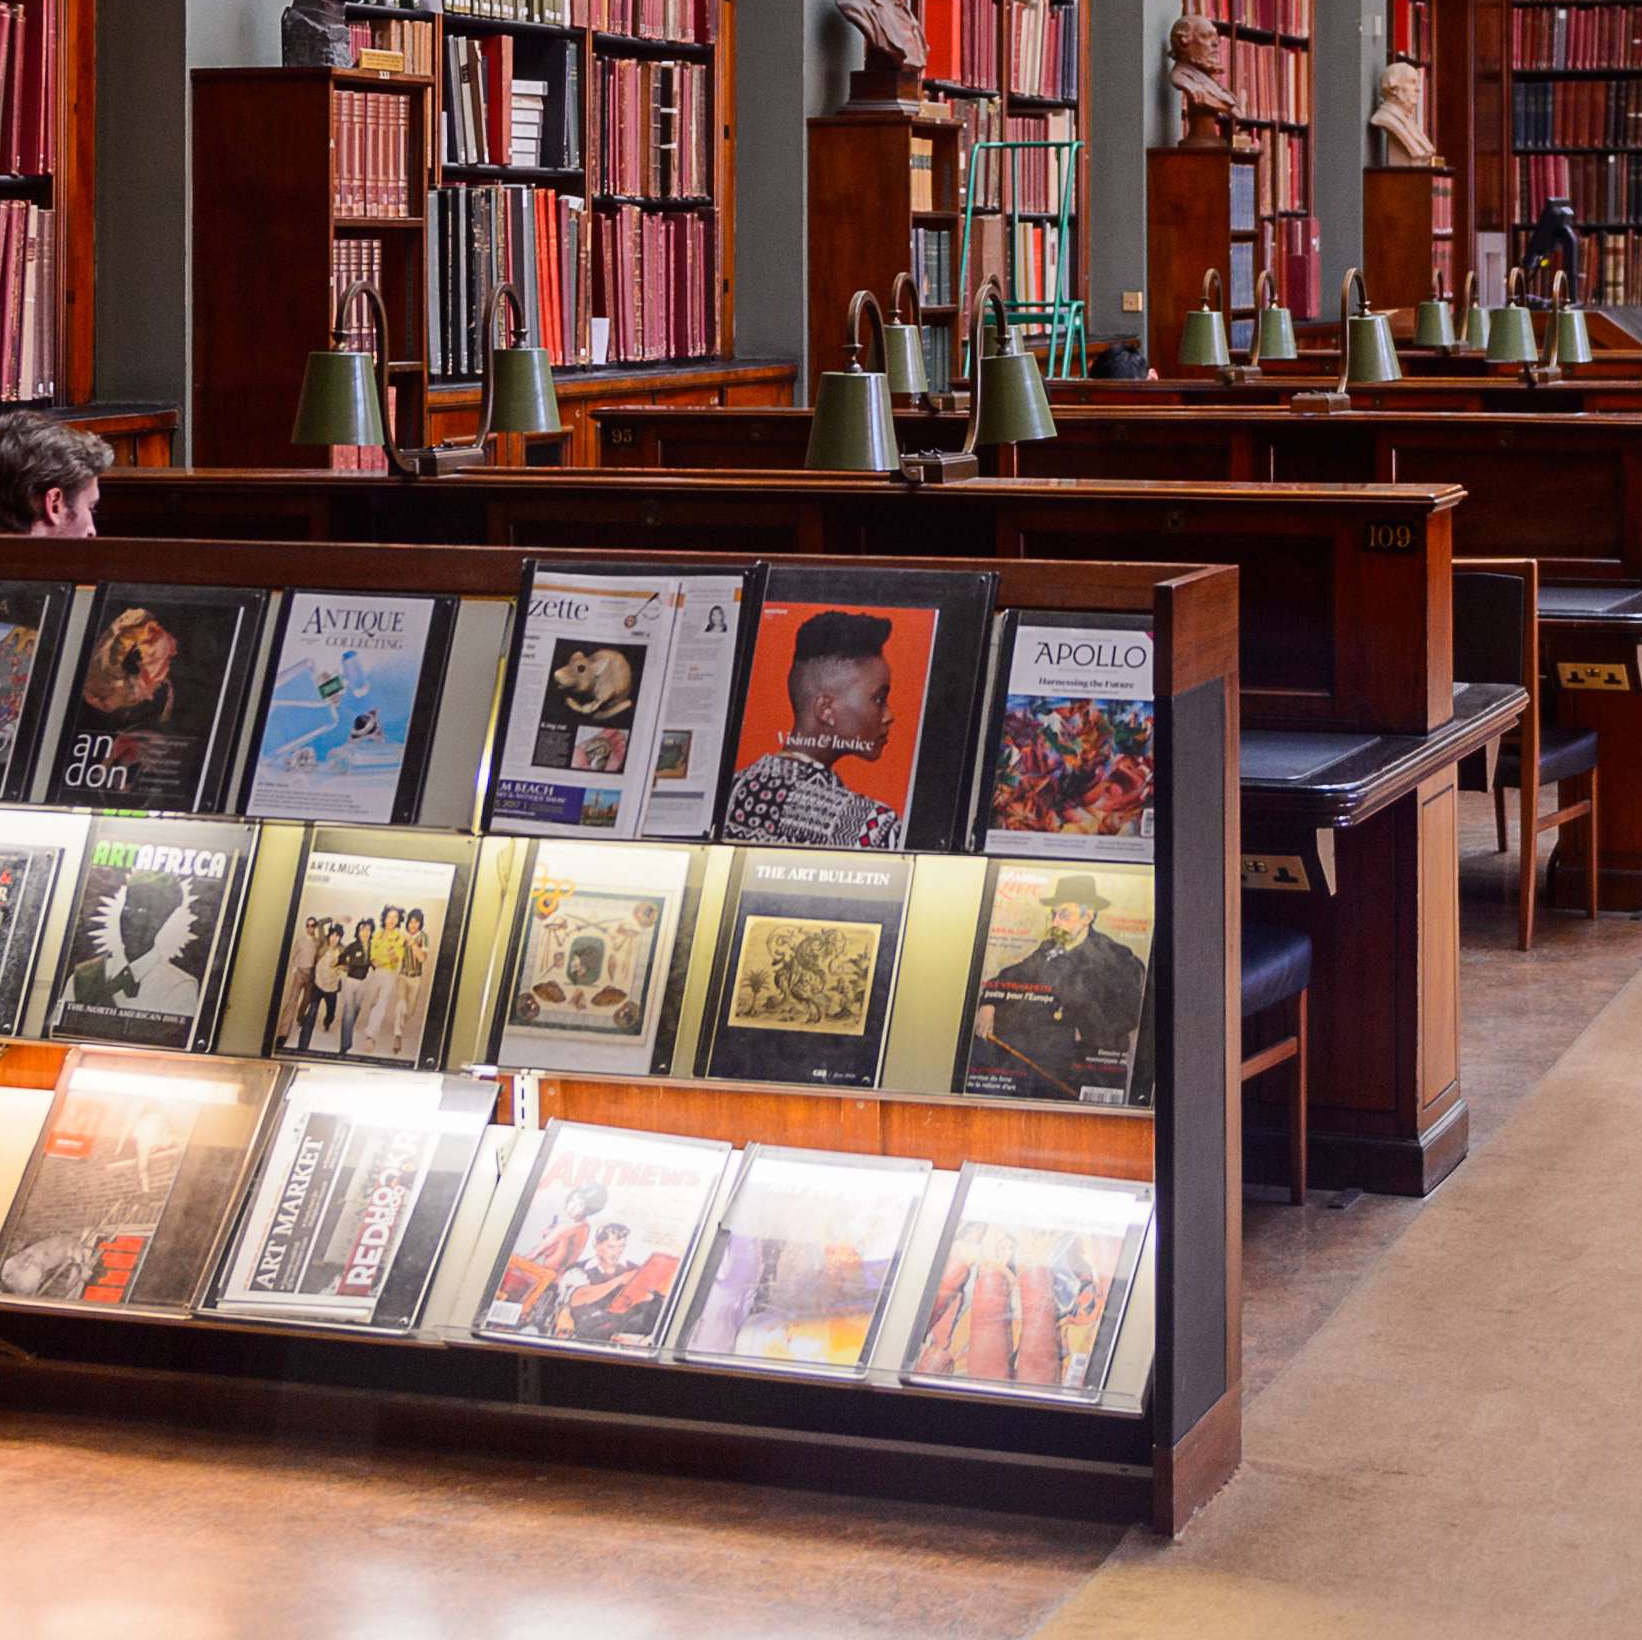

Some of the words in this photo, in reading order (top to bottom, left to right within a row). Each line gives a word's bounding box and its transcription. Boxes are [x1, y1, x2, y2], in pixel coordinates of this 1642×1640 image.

[1369, 525, 1412, 548] 109
[301, 605, 406, 638] ANTIQUE
[325, 636, 404, 651] COLLECTING
[1034, 641, 1147, 669] APOLLO
[1038, 676, 1088, 689] Harnessing
[1089, 678, 1103, 688] the
[1104, 680, 1134, 689] Future
[73, 733, 114, 759] an
[777, 730, 816, 747] Vision
[832, 734, 875, 751] Justice
[65, 762, 128, 790] don
[514, 781, 555, 797] BEACH
[756, 864, 786, 881] THE
[788, 867, 817, 882] ART
[819, 869, 890, 886] BULLETIN
[86, 1003, 117, 1017] NORTH
[256, 1239, 288, 1290] ART
[278, 1135, 324, 1238] MARKET
